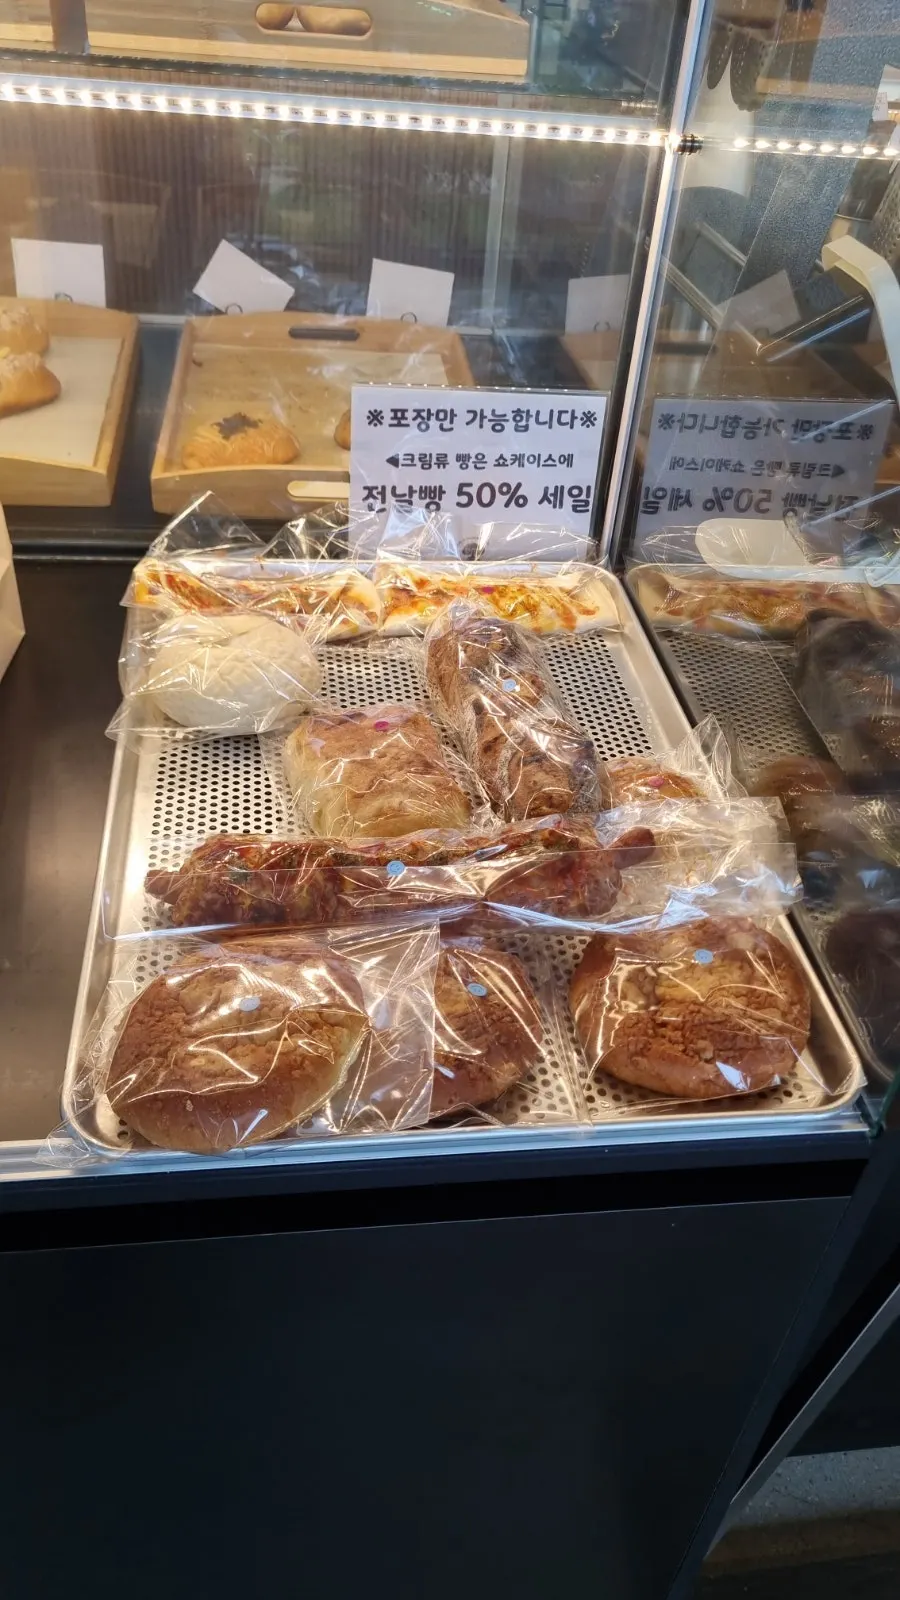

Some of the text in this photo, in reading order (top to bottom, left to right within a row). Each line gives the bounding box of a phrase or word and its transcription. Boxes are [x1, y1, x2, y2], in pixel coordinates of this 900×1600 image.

[400, 452, 574, 471] 크림류 빵은 쇼케이스에
[361, 482, 592, 515] 전날빵 50% 세일
